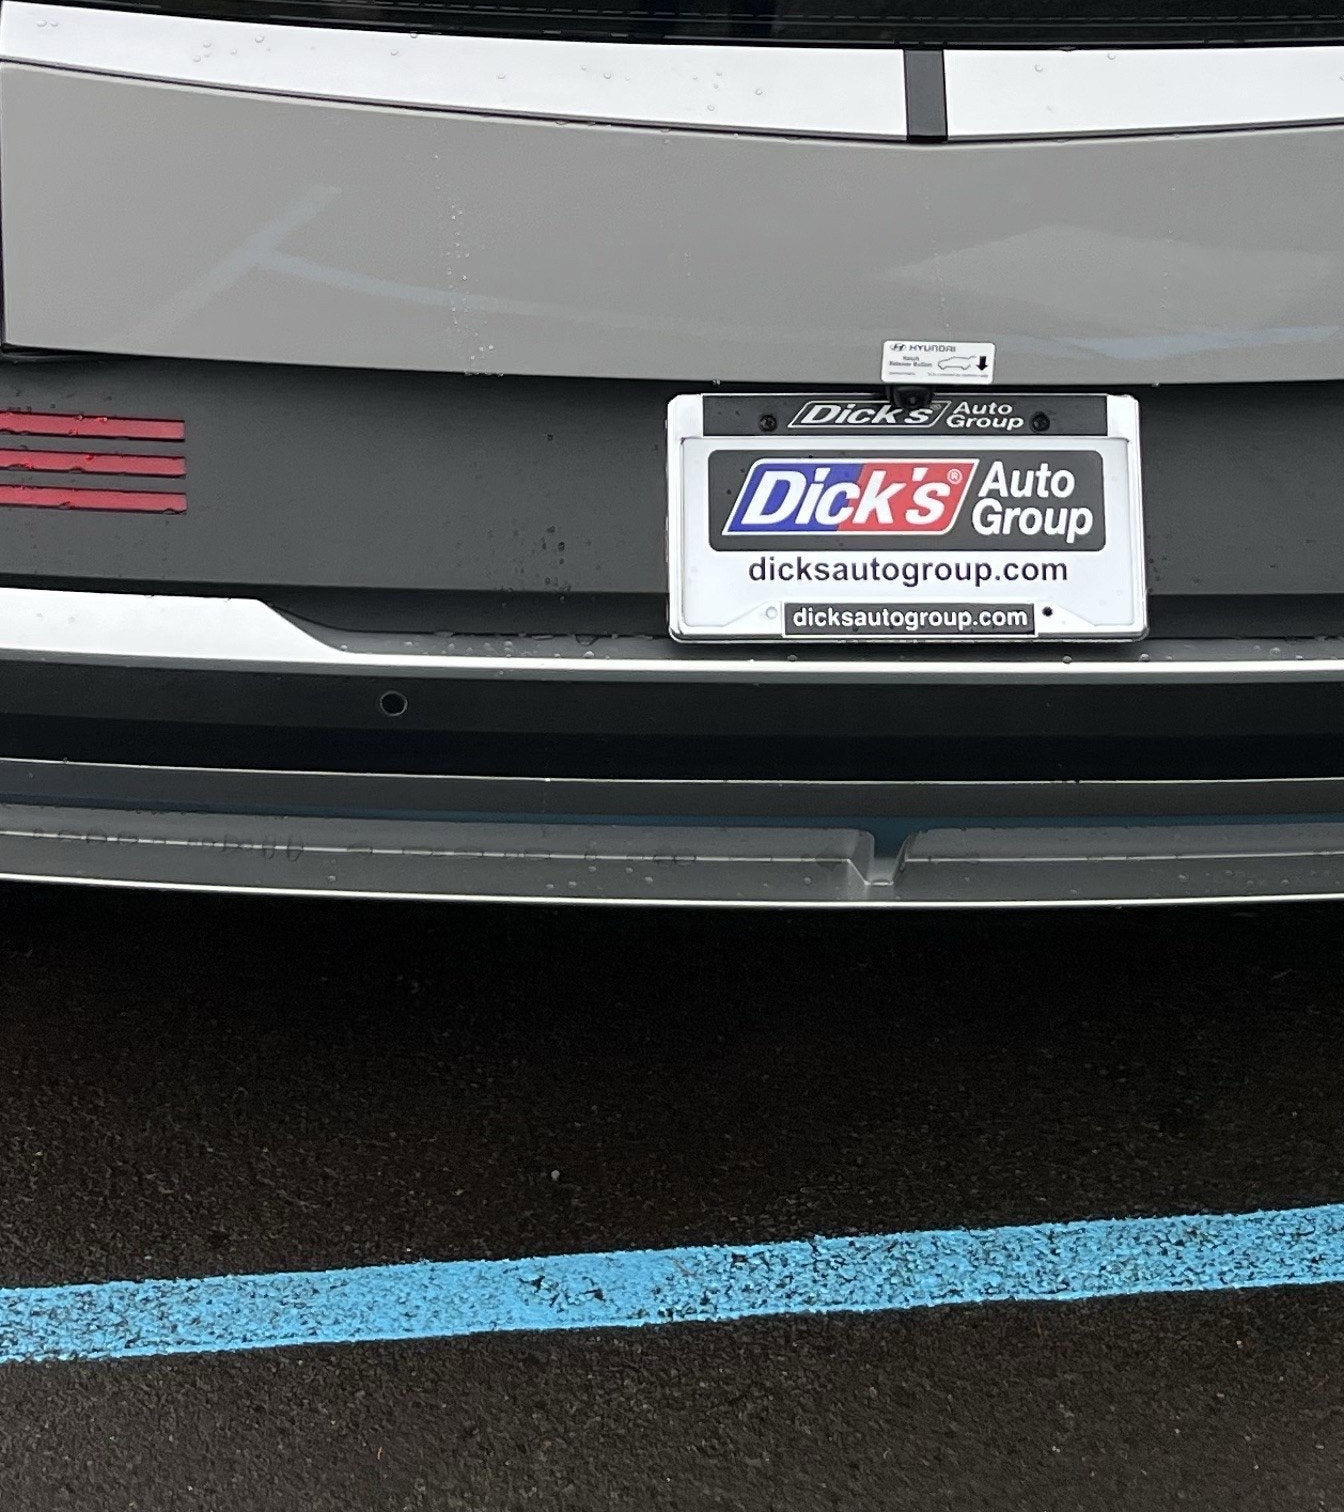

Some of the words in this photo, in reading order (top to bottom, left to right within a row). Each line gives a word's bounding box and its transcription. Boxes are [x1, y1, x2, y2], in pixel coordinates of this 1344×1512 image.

[908, 344, 956, 352] HYUNDAI
[946, 414, 1024, 430] Group
[953, 401, 1013, 415] Auto
[977, 461, 1076, 498] Auto
[741, 467, 951, 525] Dick's
[971, 497, 1093, 544] Group
[748, 556, 1069, 588] dicksautogroup.com
[792, 607, 1028, 631] dicksautogroup.com
